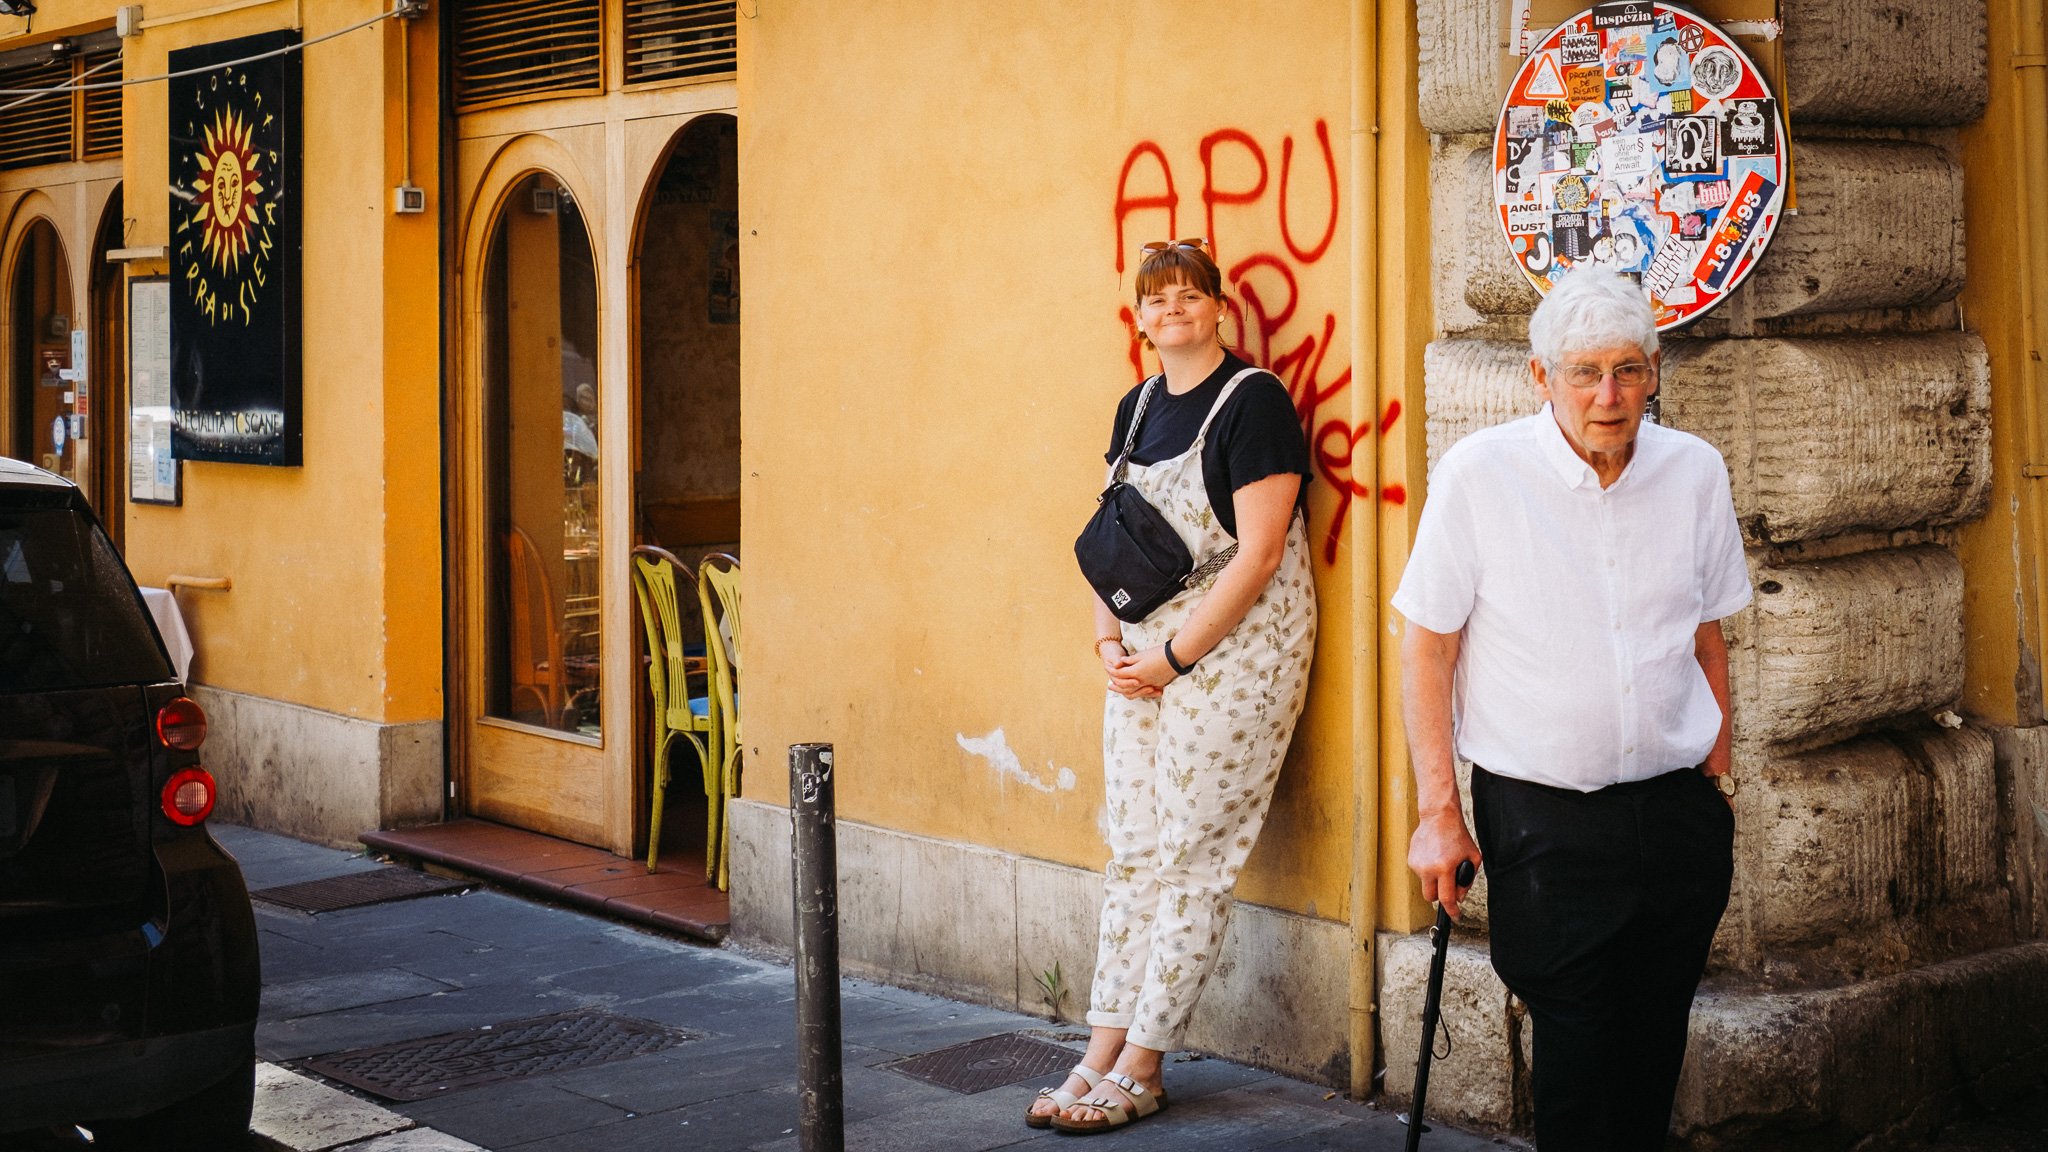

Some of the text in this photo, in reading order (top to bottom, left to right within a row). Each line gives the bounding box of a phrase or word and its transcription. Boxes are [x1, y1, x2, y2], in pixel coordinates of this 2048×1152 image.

[1595, 10, 1652, 26] laspezia
[1618, 142, 1636, 152] Wort
[1614, 161, 1640, 171] Anwalt
[1115, 118, 1339, 276] APU
[1511, 222, 1546, 232] DUST
[222, 303, 233, 321] DI
[239, 201, 277, 328] SIENA
[231, 411, 280, 437] TOSCANE
